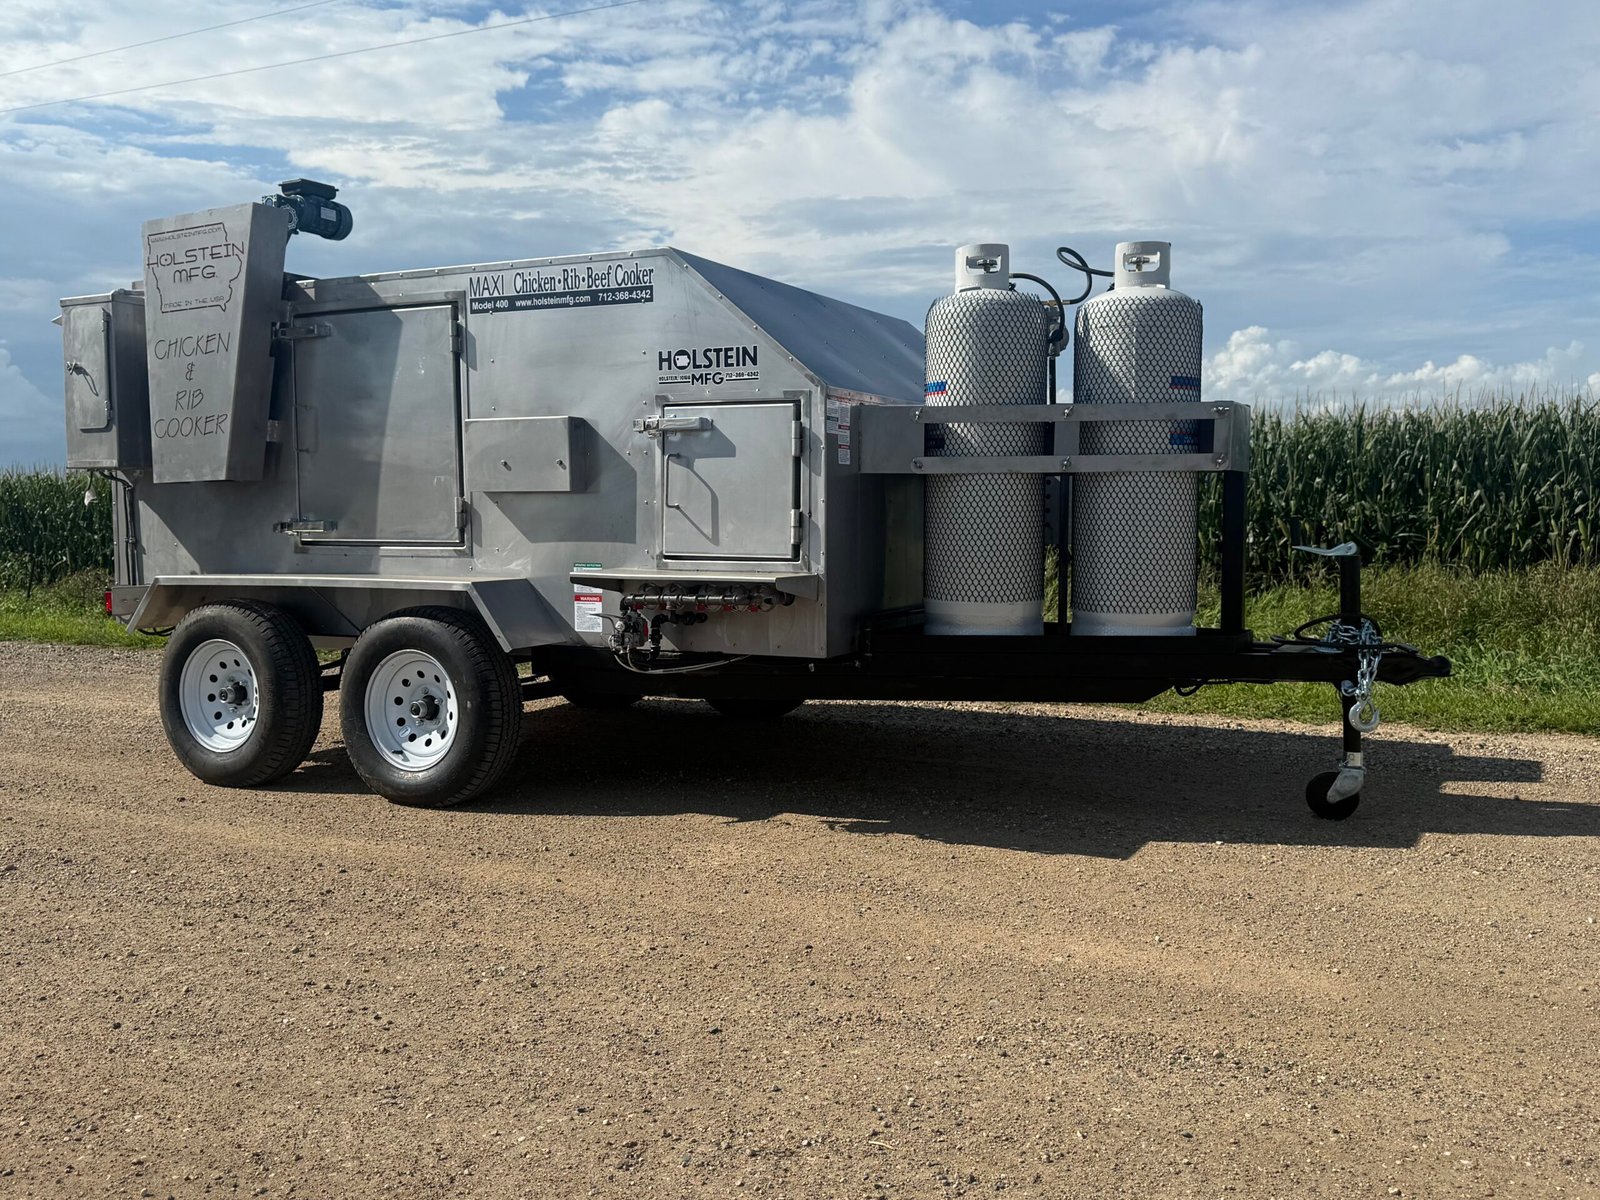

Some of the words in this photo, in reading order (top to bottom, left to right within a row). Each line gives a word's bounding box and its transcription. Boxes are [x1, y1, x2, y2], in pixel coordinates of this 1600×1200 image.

[147, 241, 245, 269] HOLSTEIN
[469, 275, 505, 297] MAXI
[614, 263, 654, 286] Cooker
[472, 303, 494, 311] Model
[495, 300, 509, 309] 400
[515, 295, 591, 308] www.holsteinmfg.com
[598, 289, 651, 302] 712-368-4342
[154, 332, 231, 360] CHICKEN
[658, 345, 758, 371] HOLSTEIN
[185, 362, 195, 381] &
[691, 371, 724, 386] MFG
[175, 388, 204, 411] RIB
[154, 413, 228, 439] COOKER
